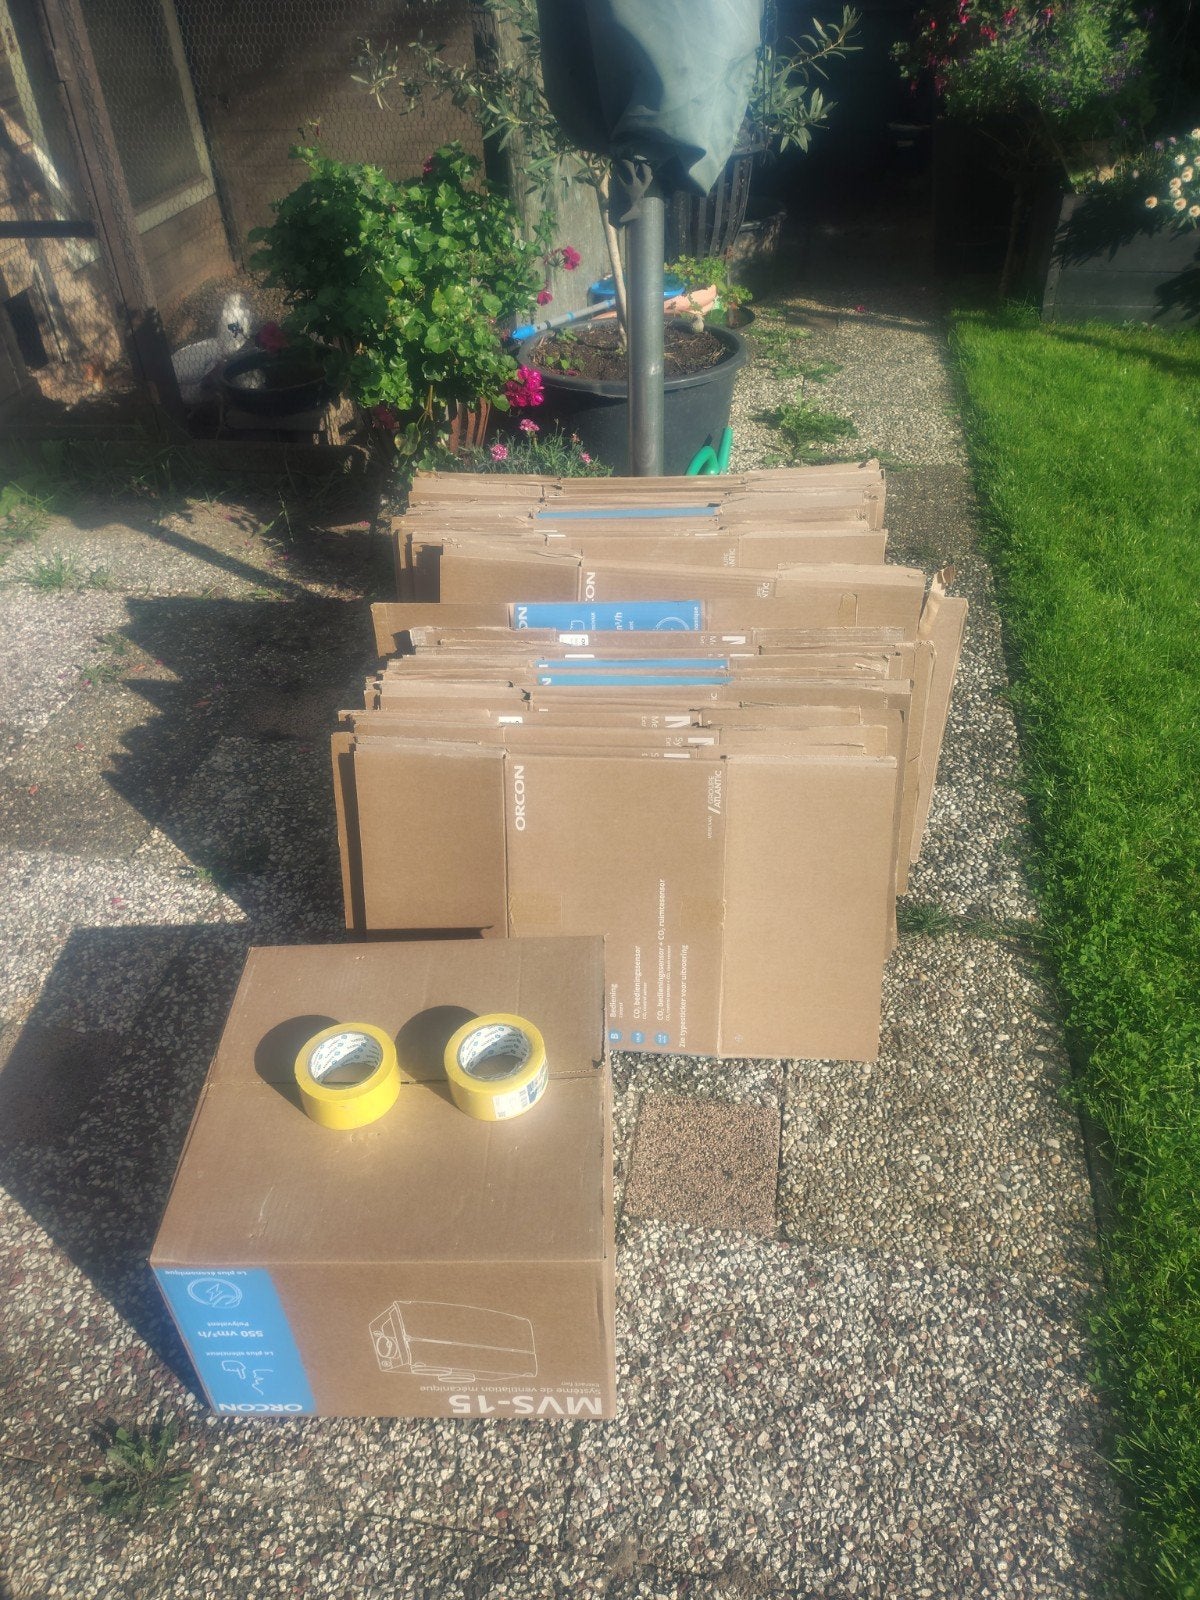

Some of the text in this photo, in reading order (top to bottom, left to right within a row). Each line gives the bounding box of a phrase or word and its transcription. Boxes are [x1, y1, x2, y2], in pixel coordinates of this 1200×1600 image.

[513, 765, 526, 831] ORCON
[714, 770, 722, 809] ATLANTIC
[658, 878, 666, 927] ruimtesensor
[633, 945, 642, 1005] bedieningssensor
[657, 947, 666, 1007] bedieningssensor
[679, 944, 689, 981] uitvoering
[609, 983, 618, 1018] Bediening
[679, 998, 688, 1036] typesticker
[240, 1330, 264, 1338] 550
[219, 1403, 303, 1412] ORCON
[419, 1384, 602, 1395] Système de ventilation mécanique
[448, 1394, 603, 1415] MVS-15
